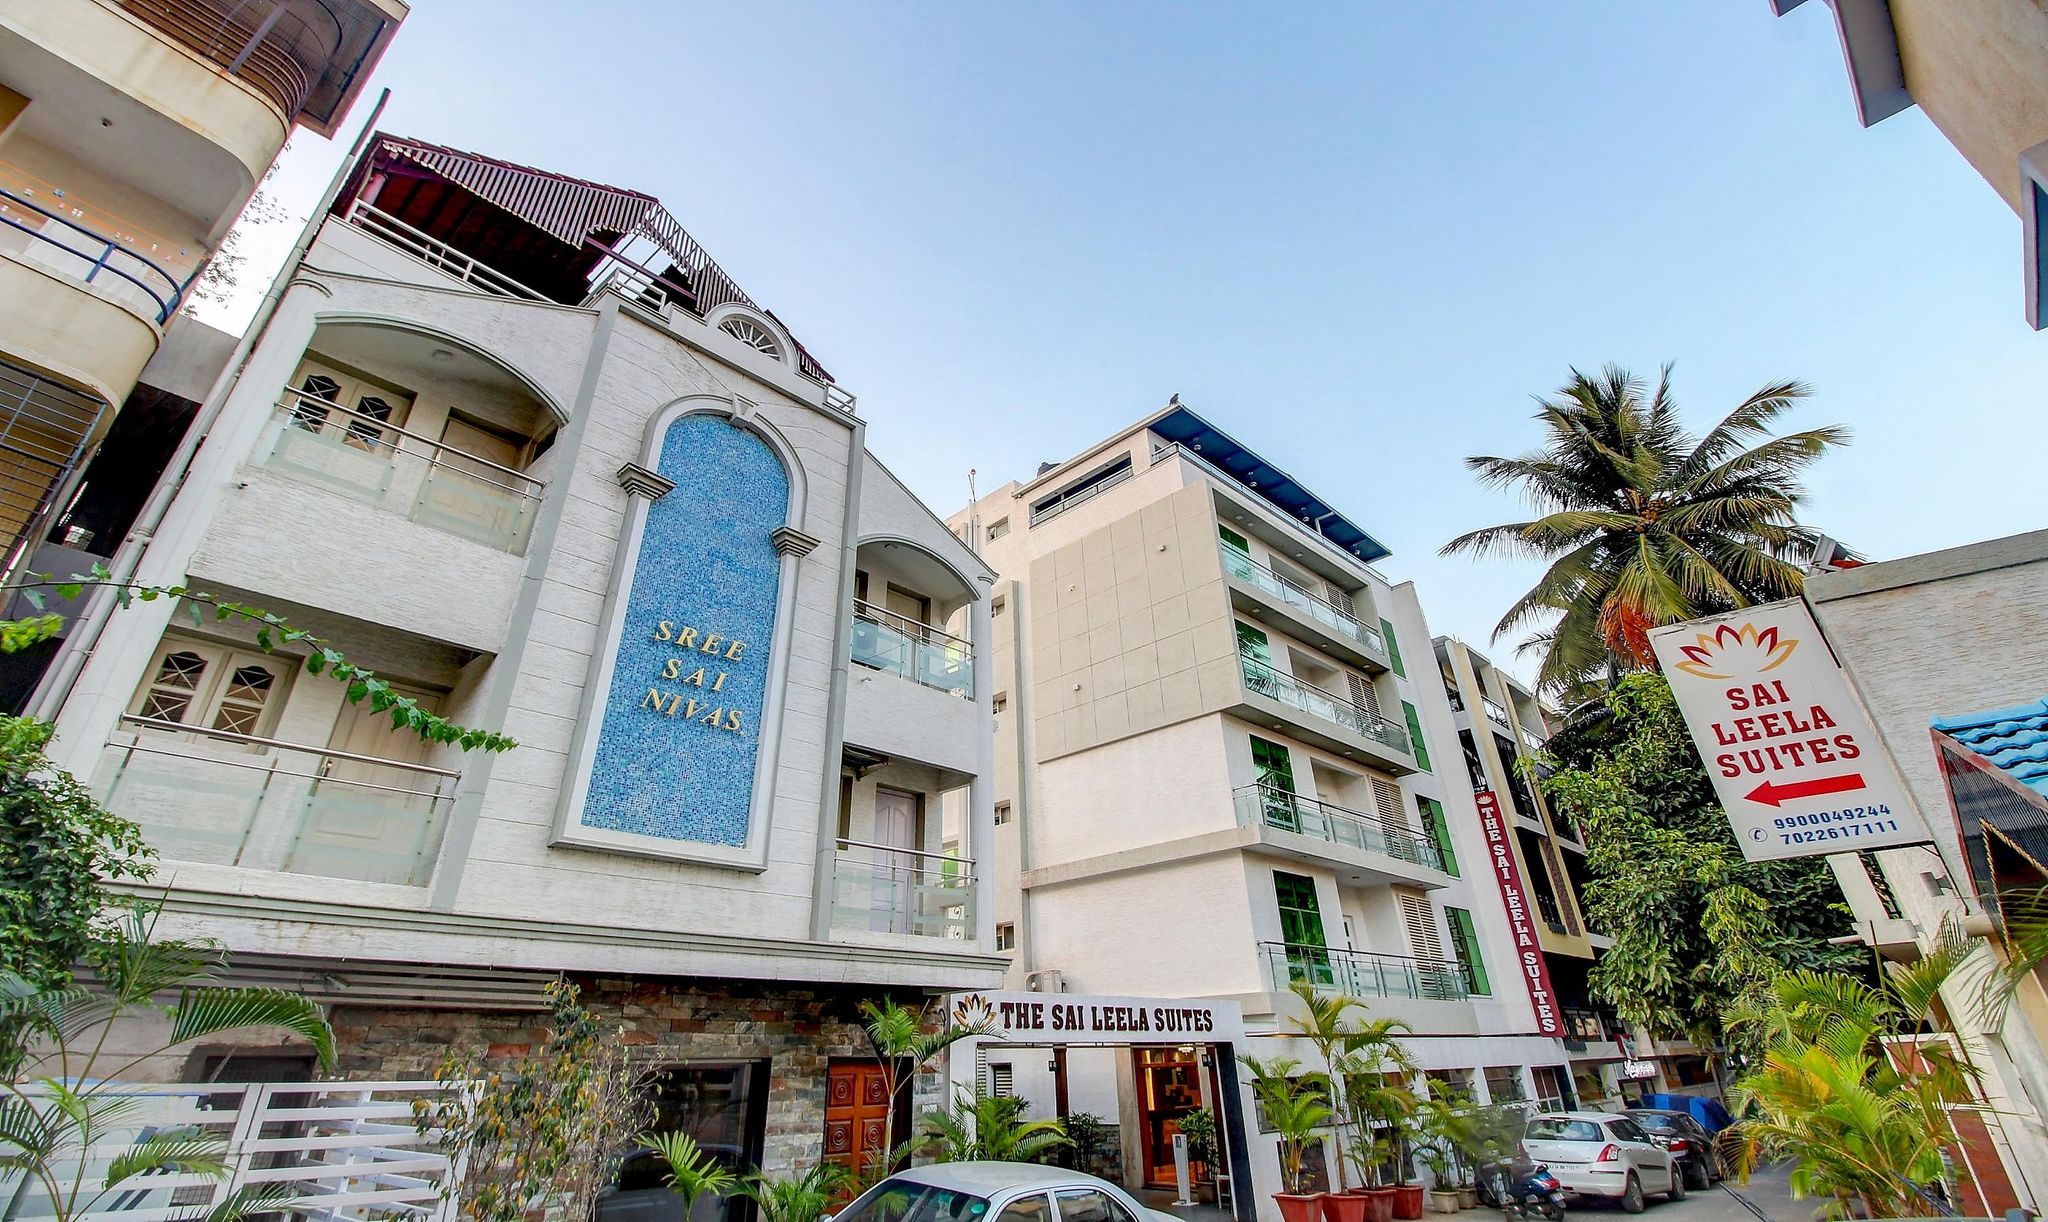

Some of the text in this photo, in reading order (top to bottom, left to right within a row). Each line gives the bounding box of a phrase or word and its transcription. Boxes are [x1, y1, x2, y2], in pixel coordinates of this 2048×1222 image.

[655, 620, 748, 661] SREE
[662, 658, 728, 692] SAI
[1726, 680, 1790, 710] SAI
[1711, 705, 1836, 746] LEELA
[1716, 734, 1861, 778] SUITES
[1774, 804, 1891, 830] 9900049244
[1780, 820, 1898, 845] 7022617111
[1481, 806, 1556, 1033] THE SAI LEELA SUITES
[1001, 1002, 1213, 1032] THE SAI LEELA SUITES
